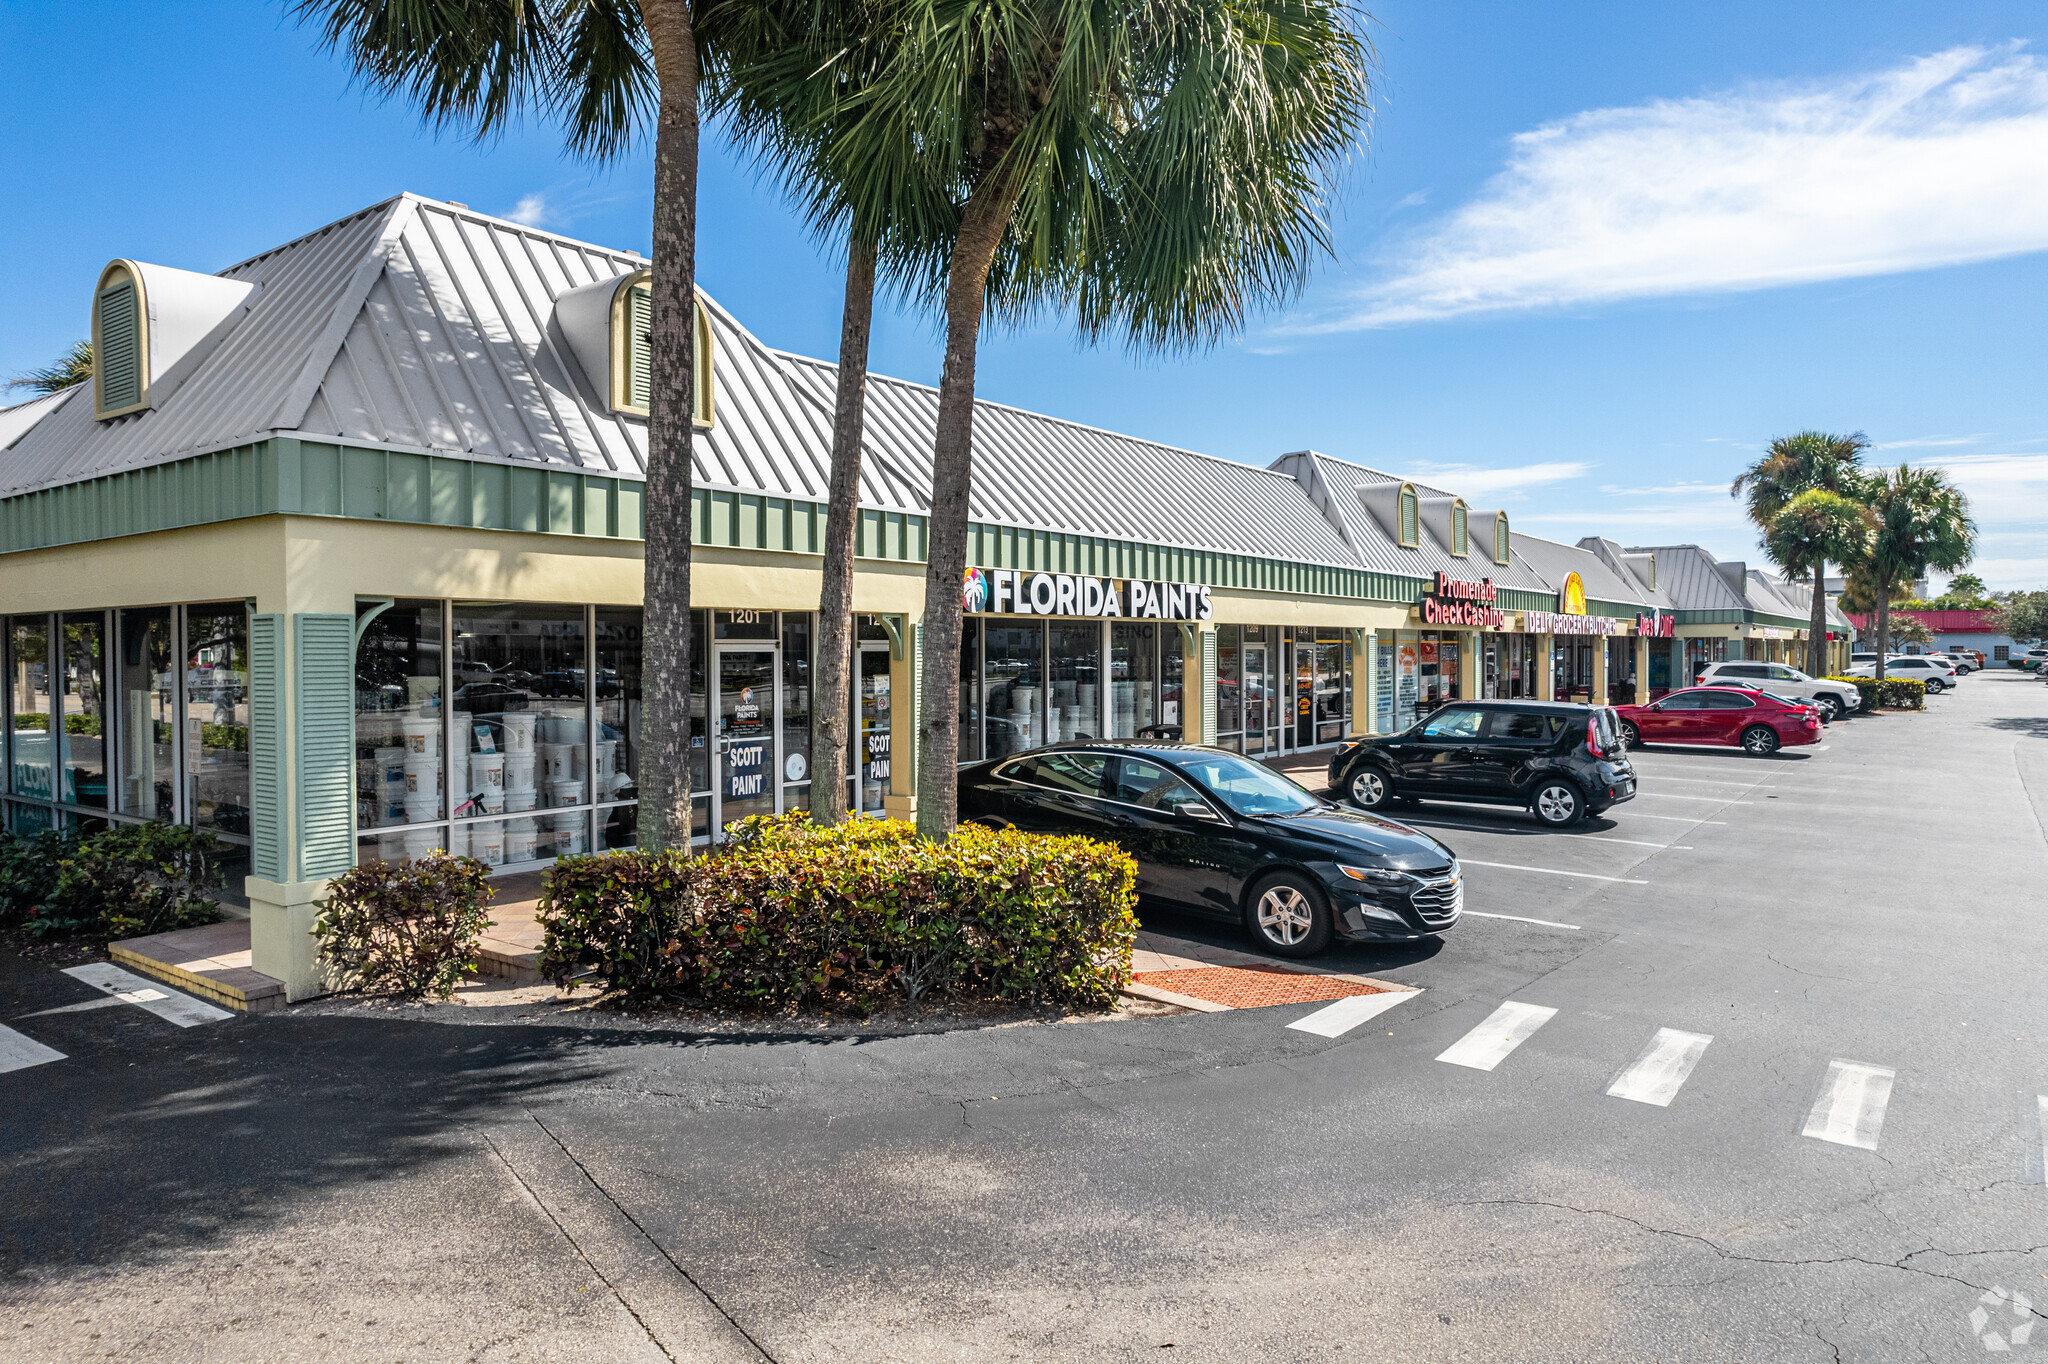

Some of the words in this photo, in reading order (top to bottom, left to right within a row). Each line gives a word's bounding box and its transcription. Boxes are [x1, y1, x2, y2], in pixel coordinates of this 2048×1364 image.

[993, 570, 1122, 618] FLORIDA
[1130, 580, 1214, 621] PAINTS
[1438, 571, 1497, 602] Promenade
[729, 609, 760, 624] 1201
[1425, 597, 1464, 625] Check
[1464, 601, 1505, 632] Cashing
[1529, 611, 1548, 634] DELI
[1553, 613, 1586, 635] GROCERY
[1589, 615, 1617, 635] BUTCHER
[735, 704, 760, 712] FLORIDA
[737, 711, 758, 719] PAINTS
[869, 735, 890, 753] SCOT
[730, 746, 763, 768] SCOTT
[870, 760, 890, 779] PAIN
[732, 774, 763, 796] PAINT
